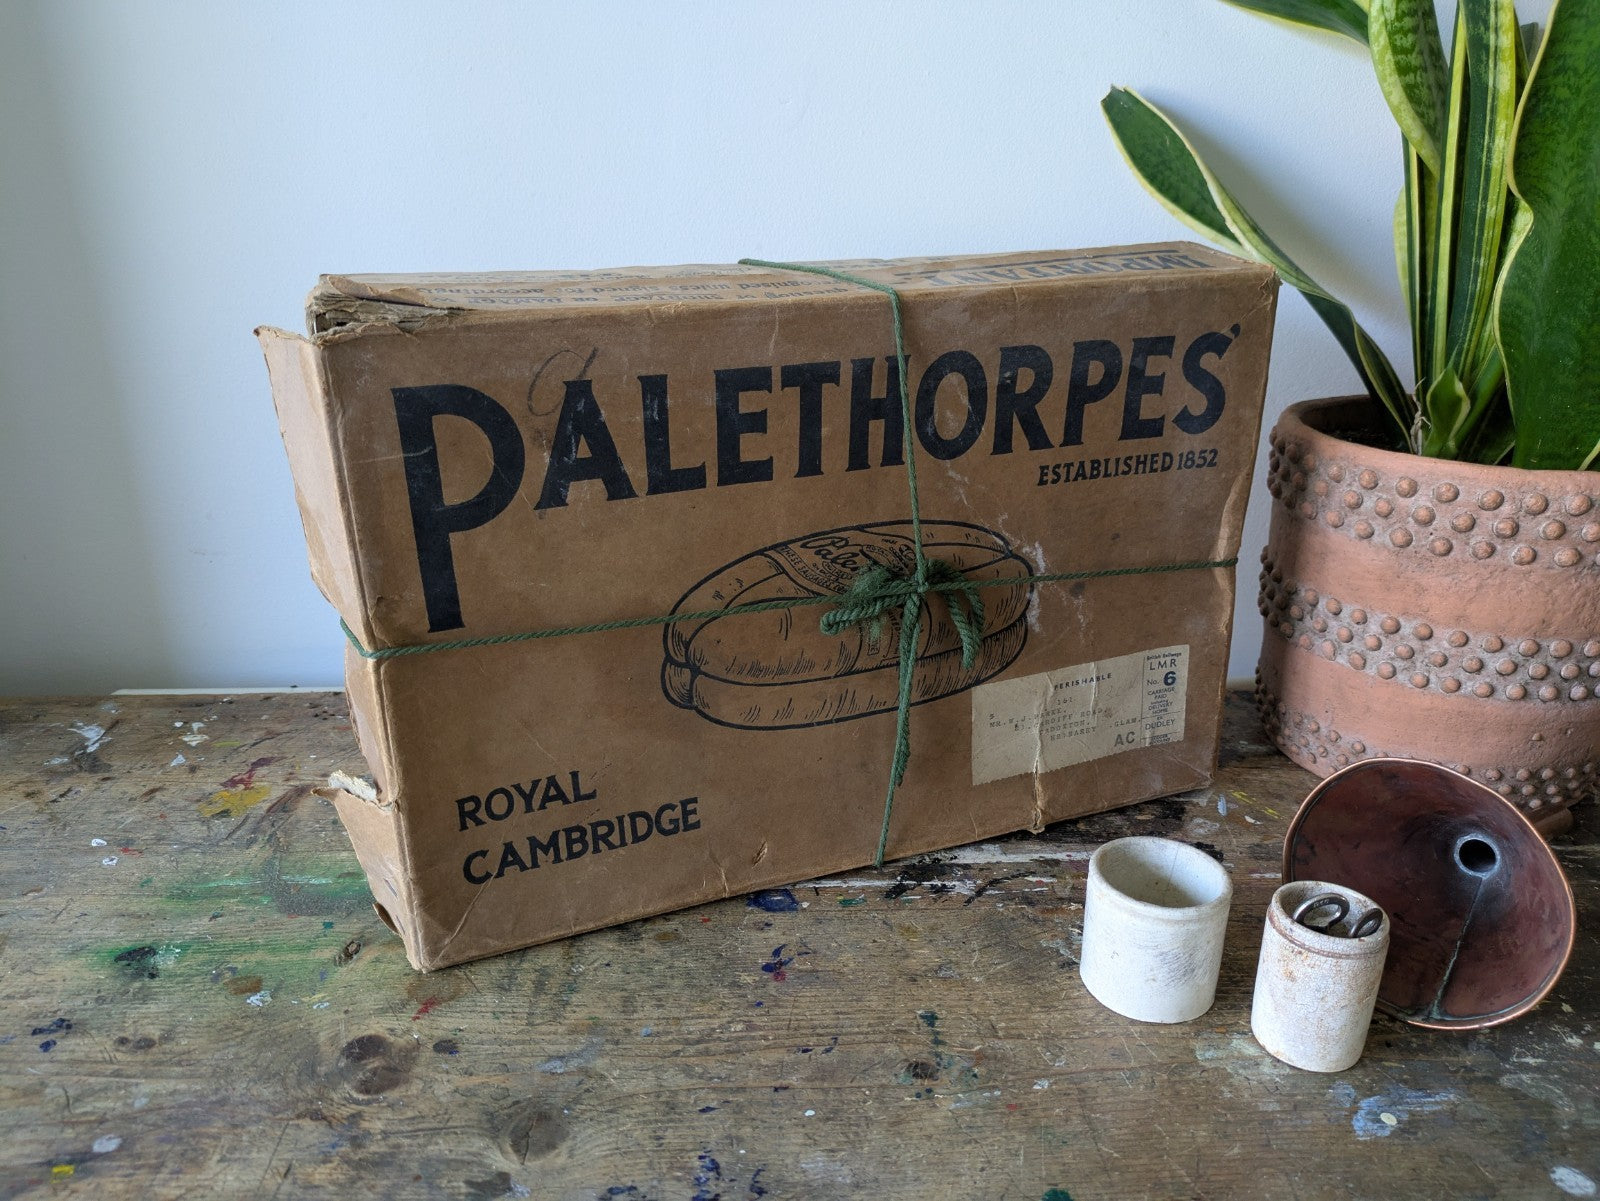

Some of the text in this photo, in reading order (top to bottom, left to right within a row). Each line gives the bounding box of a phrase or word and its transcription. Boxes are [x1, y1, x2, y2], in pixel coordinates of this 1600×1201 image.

[924, 252, 1215, 286] IMPORTANT
[1037, 448, 1220, 486] ESTABLISHED 1852
[1054, 672, 1113, 691] PERISHABLE
[1163, 671, 1177, 686] 6
[1145, 718, 1176, 730] DUDLEY
[1114, 731, 1136, 747] AC
[455, 770, 598, 832] ROYAL
[463, 796, 701, 885] CAMBRIDGE
